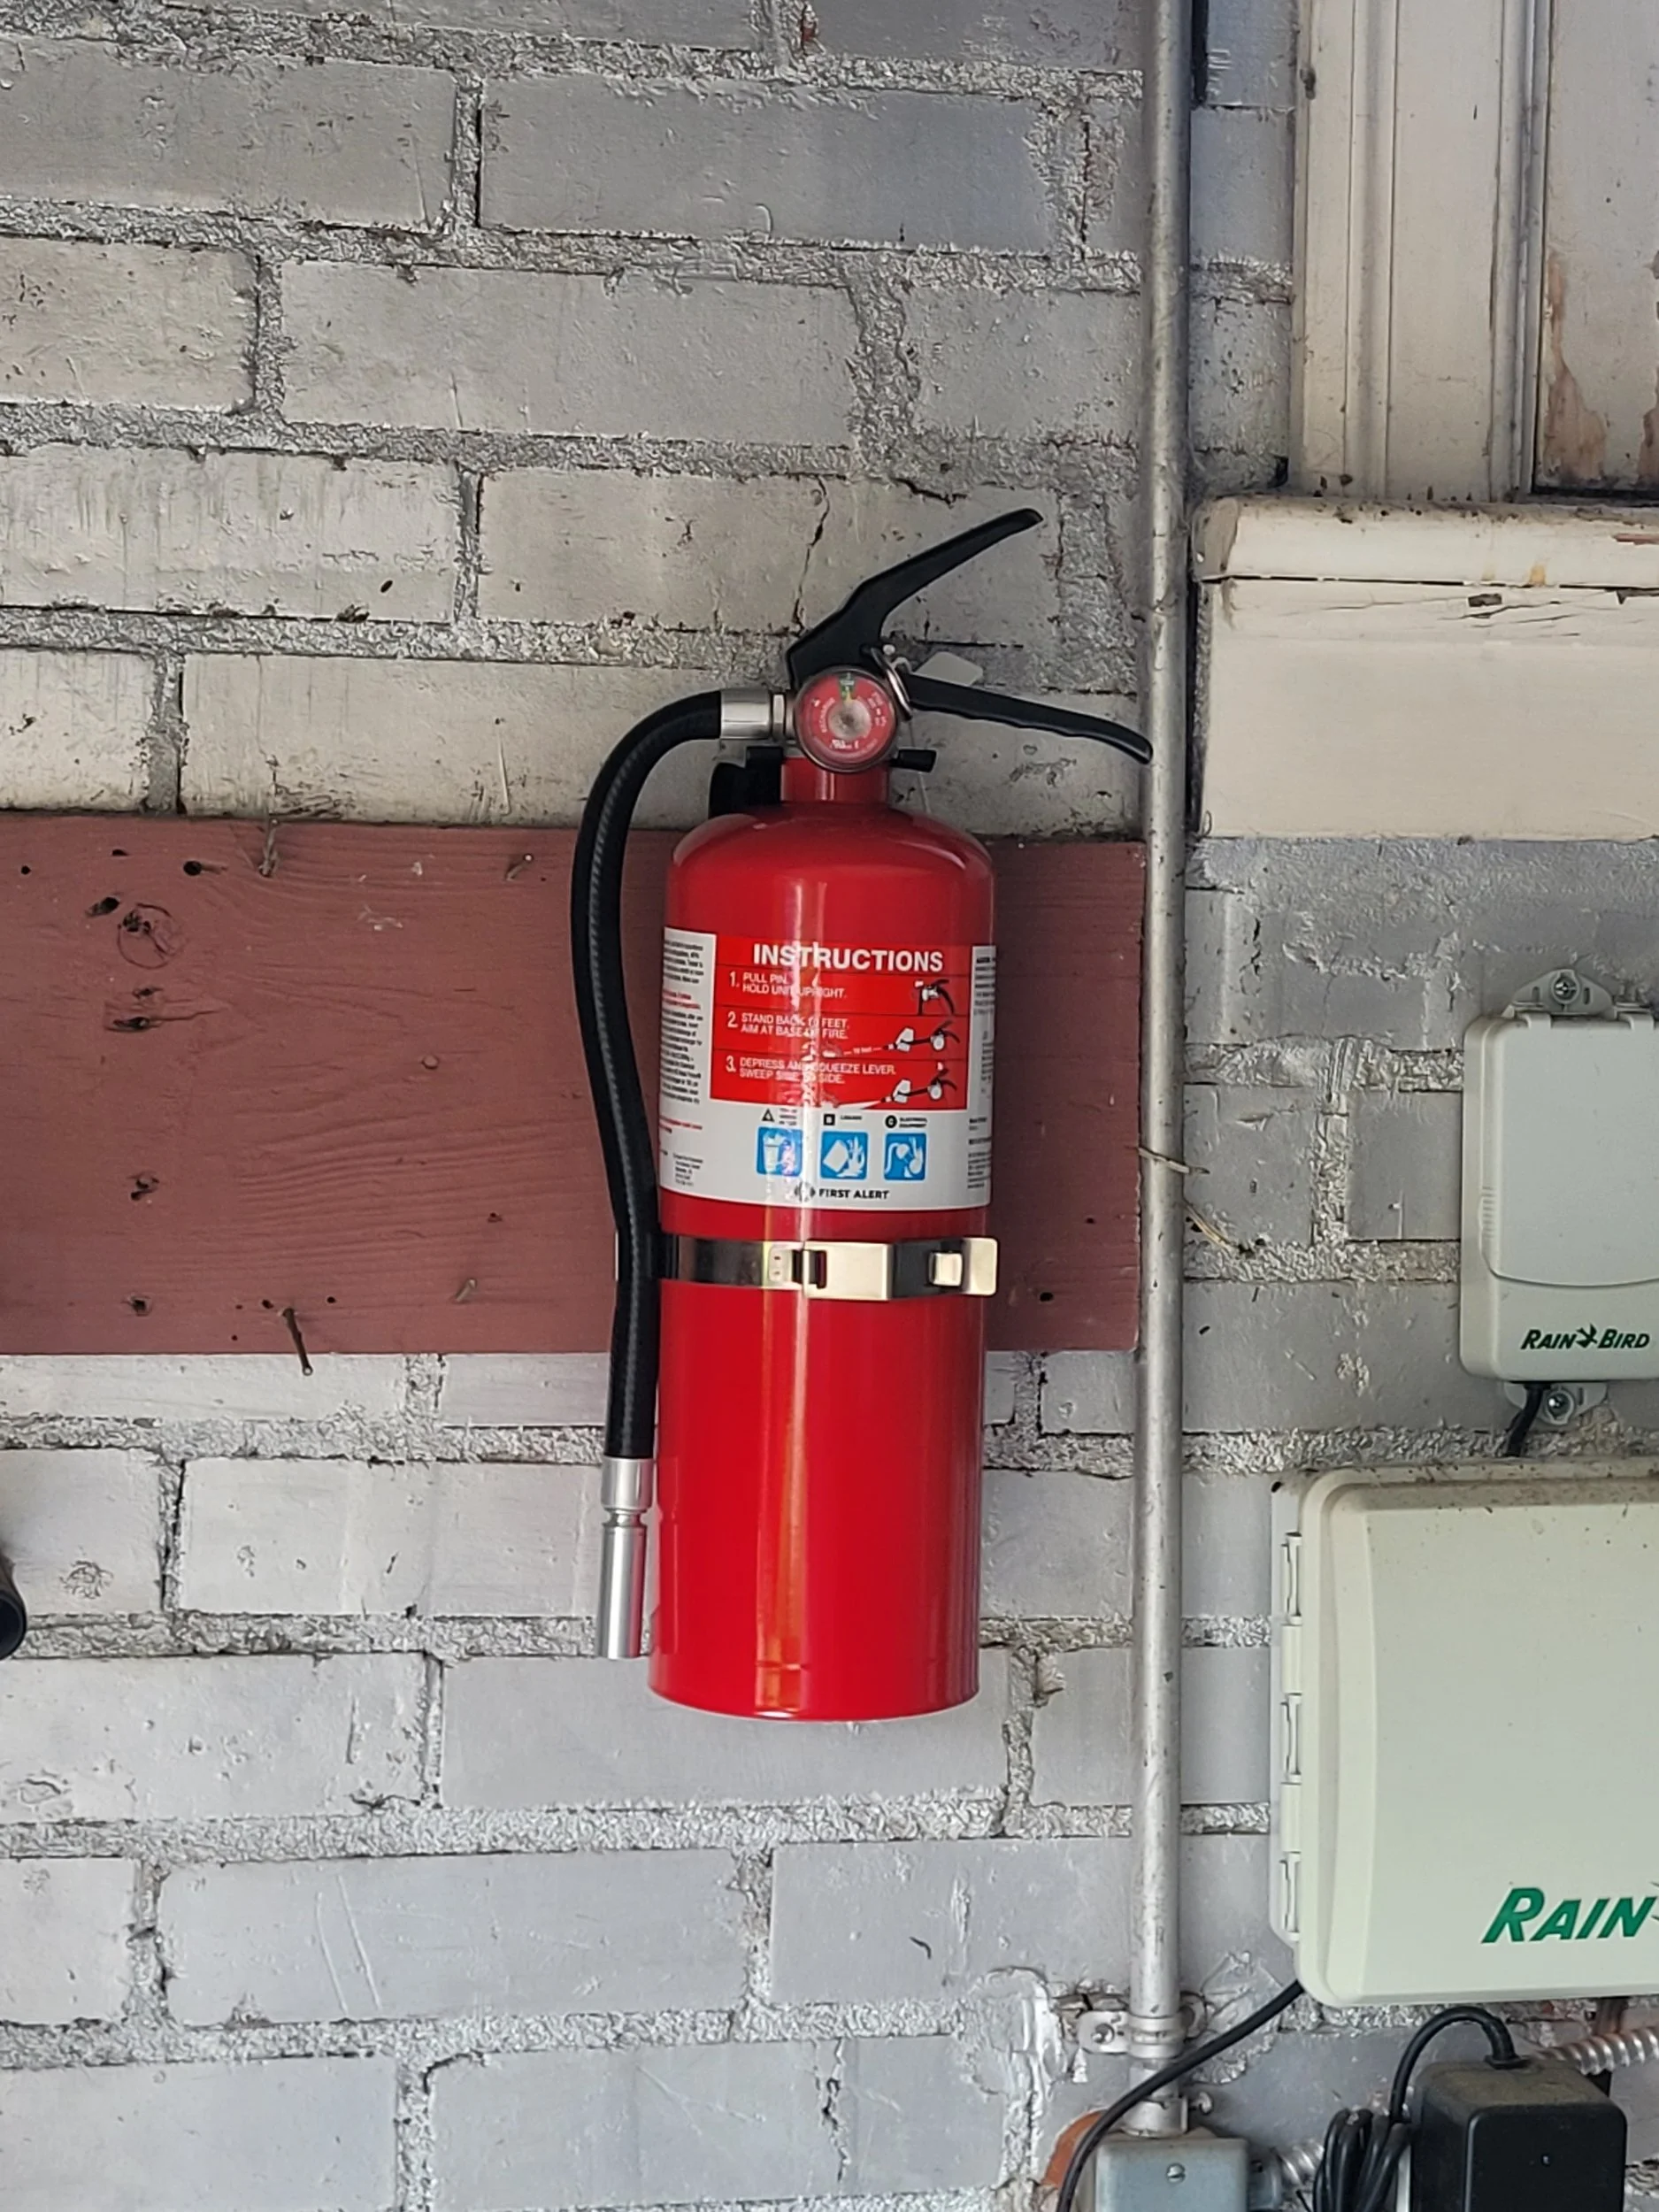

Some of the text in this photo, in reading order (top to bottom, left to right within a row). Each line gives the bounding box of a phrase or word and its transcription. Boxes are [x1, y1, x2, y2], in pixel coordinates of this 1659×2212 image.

[754, 943, 943, 972] INSTRUCTIONS
[730, 971, 740, 987] 1.
[743, 972, 767, 984] PULL
[743, 984, 769, 995] HOLD
[771, 985, 795, 996] UNI
[741, 1012, 773, 1025] STAND
[775, 1014, 806, 1026] BACK
[741, 1024, 759, 1034] AIM
[759, 1025, 773, 1035] AT
[775, 1026, 802, 1038] BASE
[740, 1056, 785, 1070] DEPRESS
[739, 1067, 773, 1079] SWEEP
[818, 1188, 889, 1200] FIRST ALERT
[1520, 1328, 1650, 1350] RAIN BIRD
[1481, 1887, 1657, 1943] RAIN
